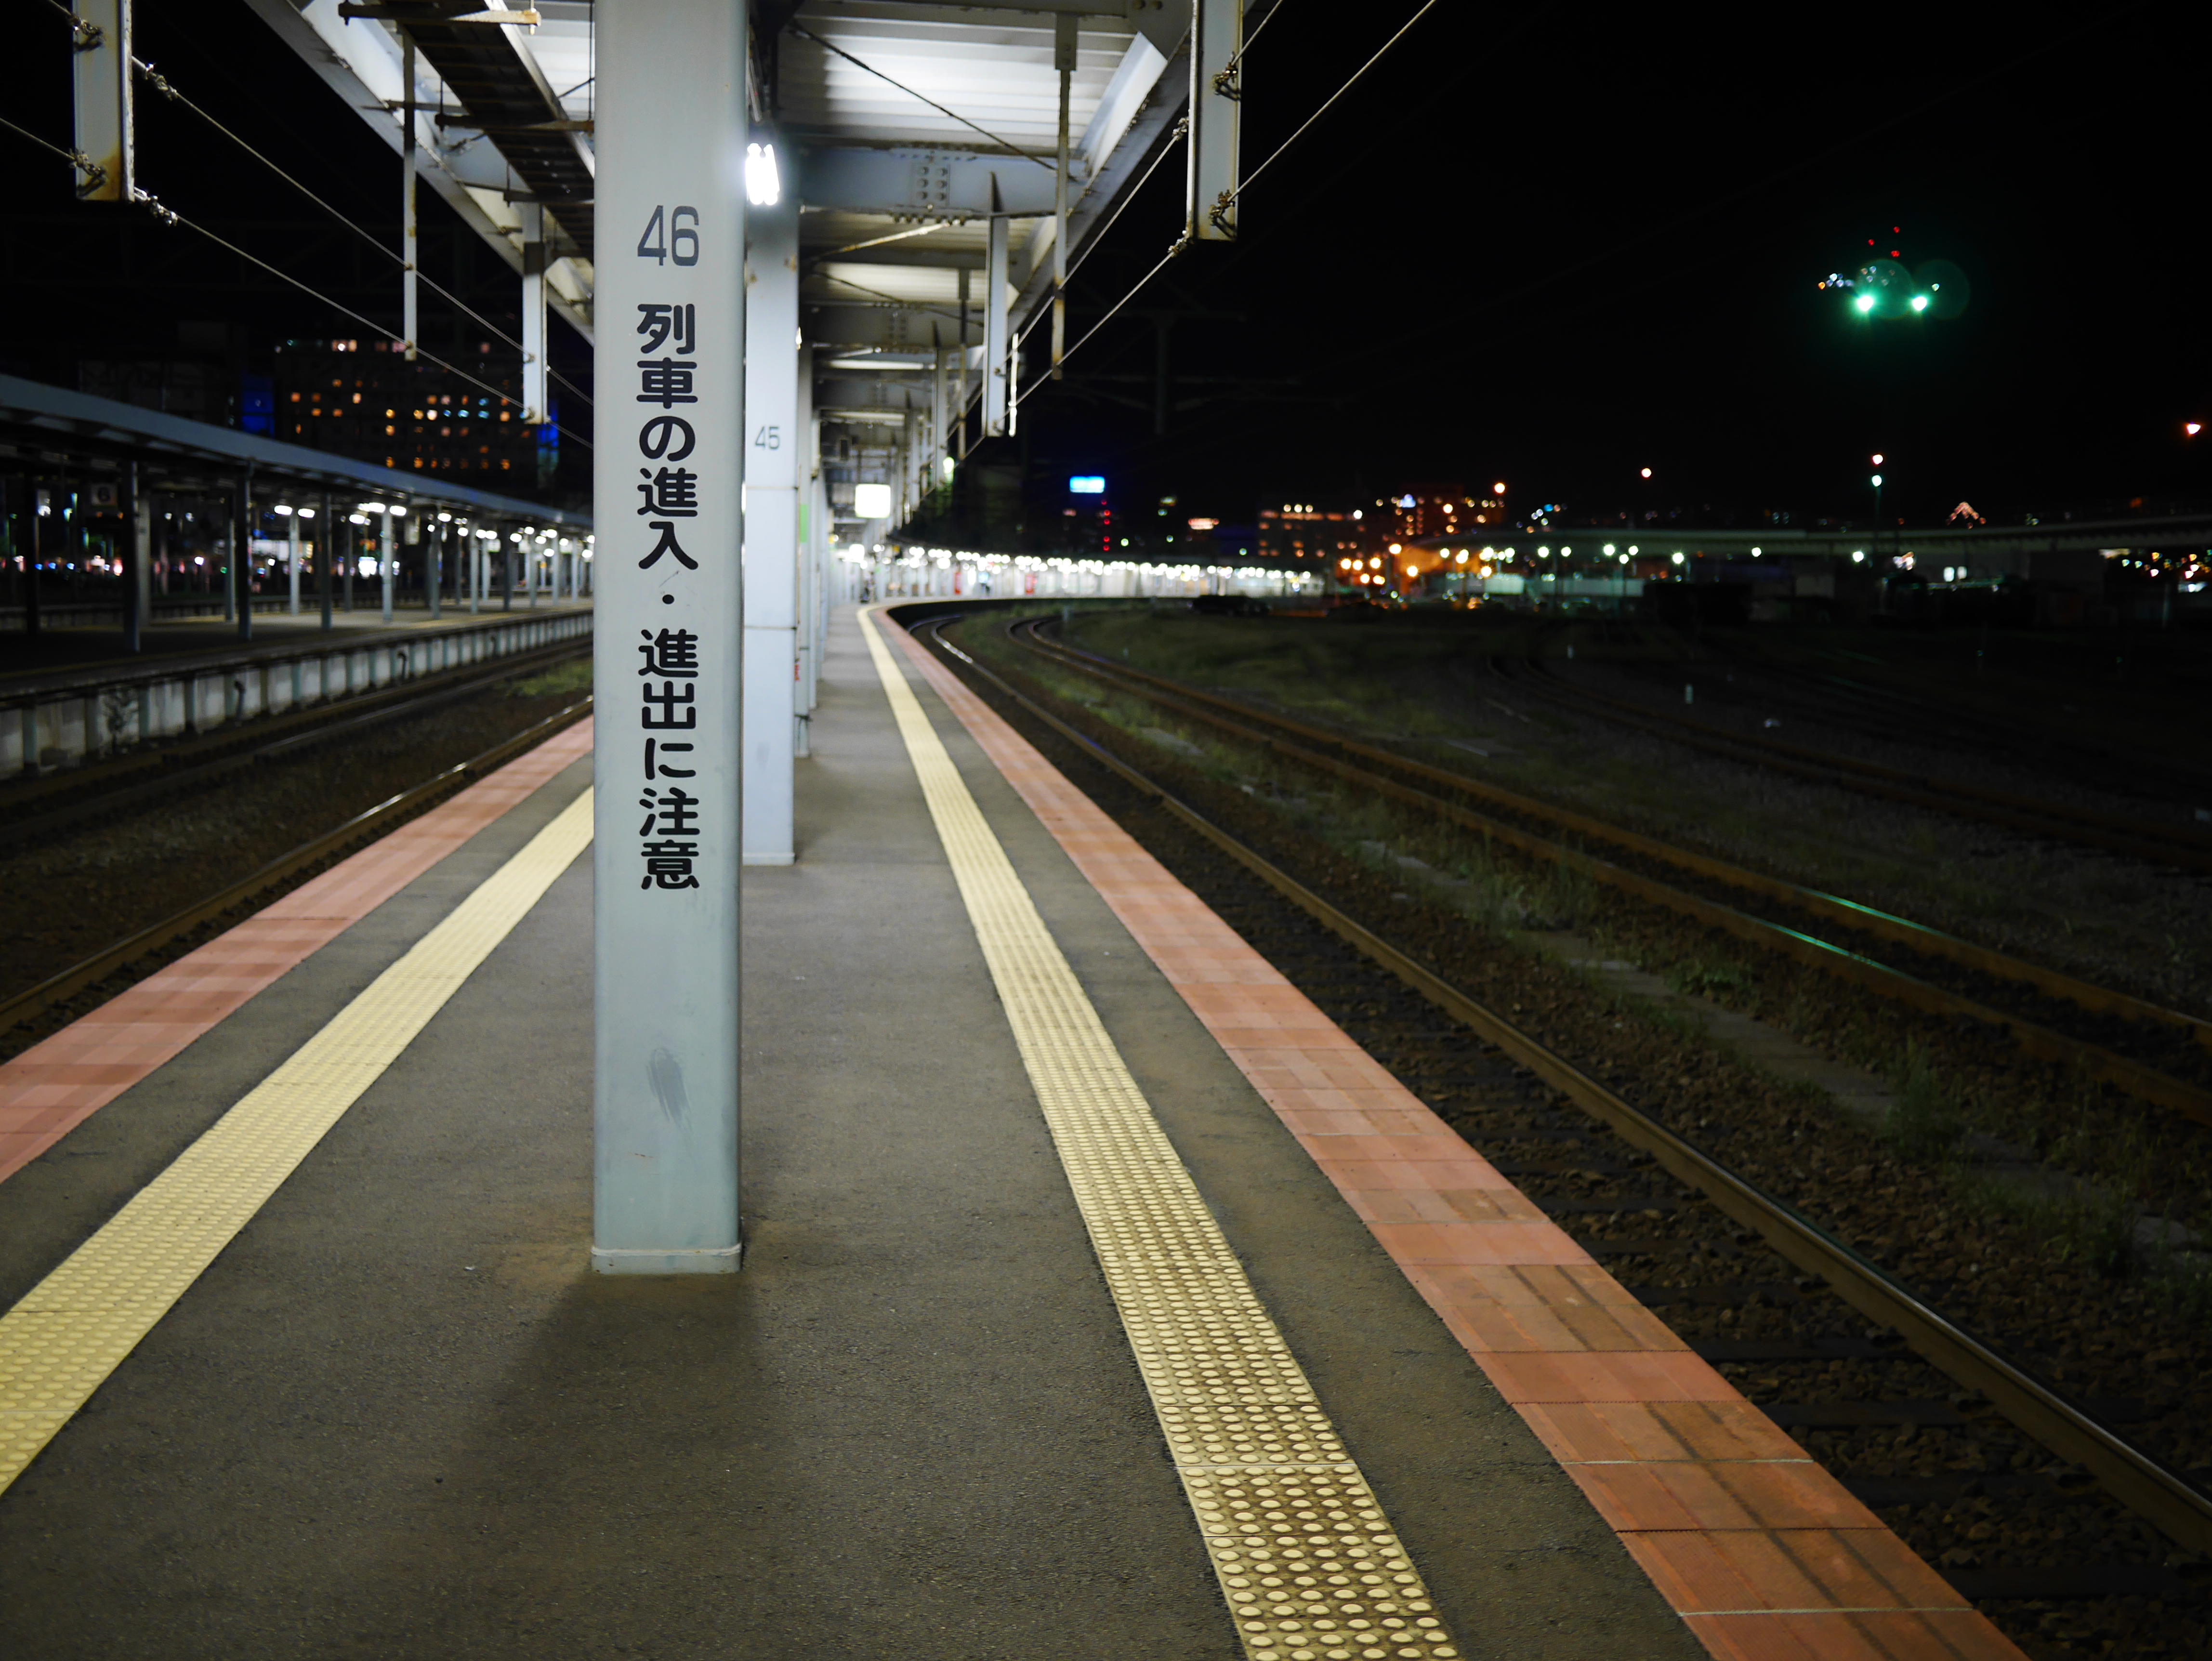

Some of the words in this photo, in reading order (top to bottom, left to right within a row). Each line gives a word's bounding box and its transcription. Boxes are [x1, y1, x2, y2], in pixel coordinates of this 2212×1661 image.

[637, 205, 699, 266] 46
[754, 426, 780, 450] 45
[636, 303, 701, 890] 列車の進入・進出に注意
